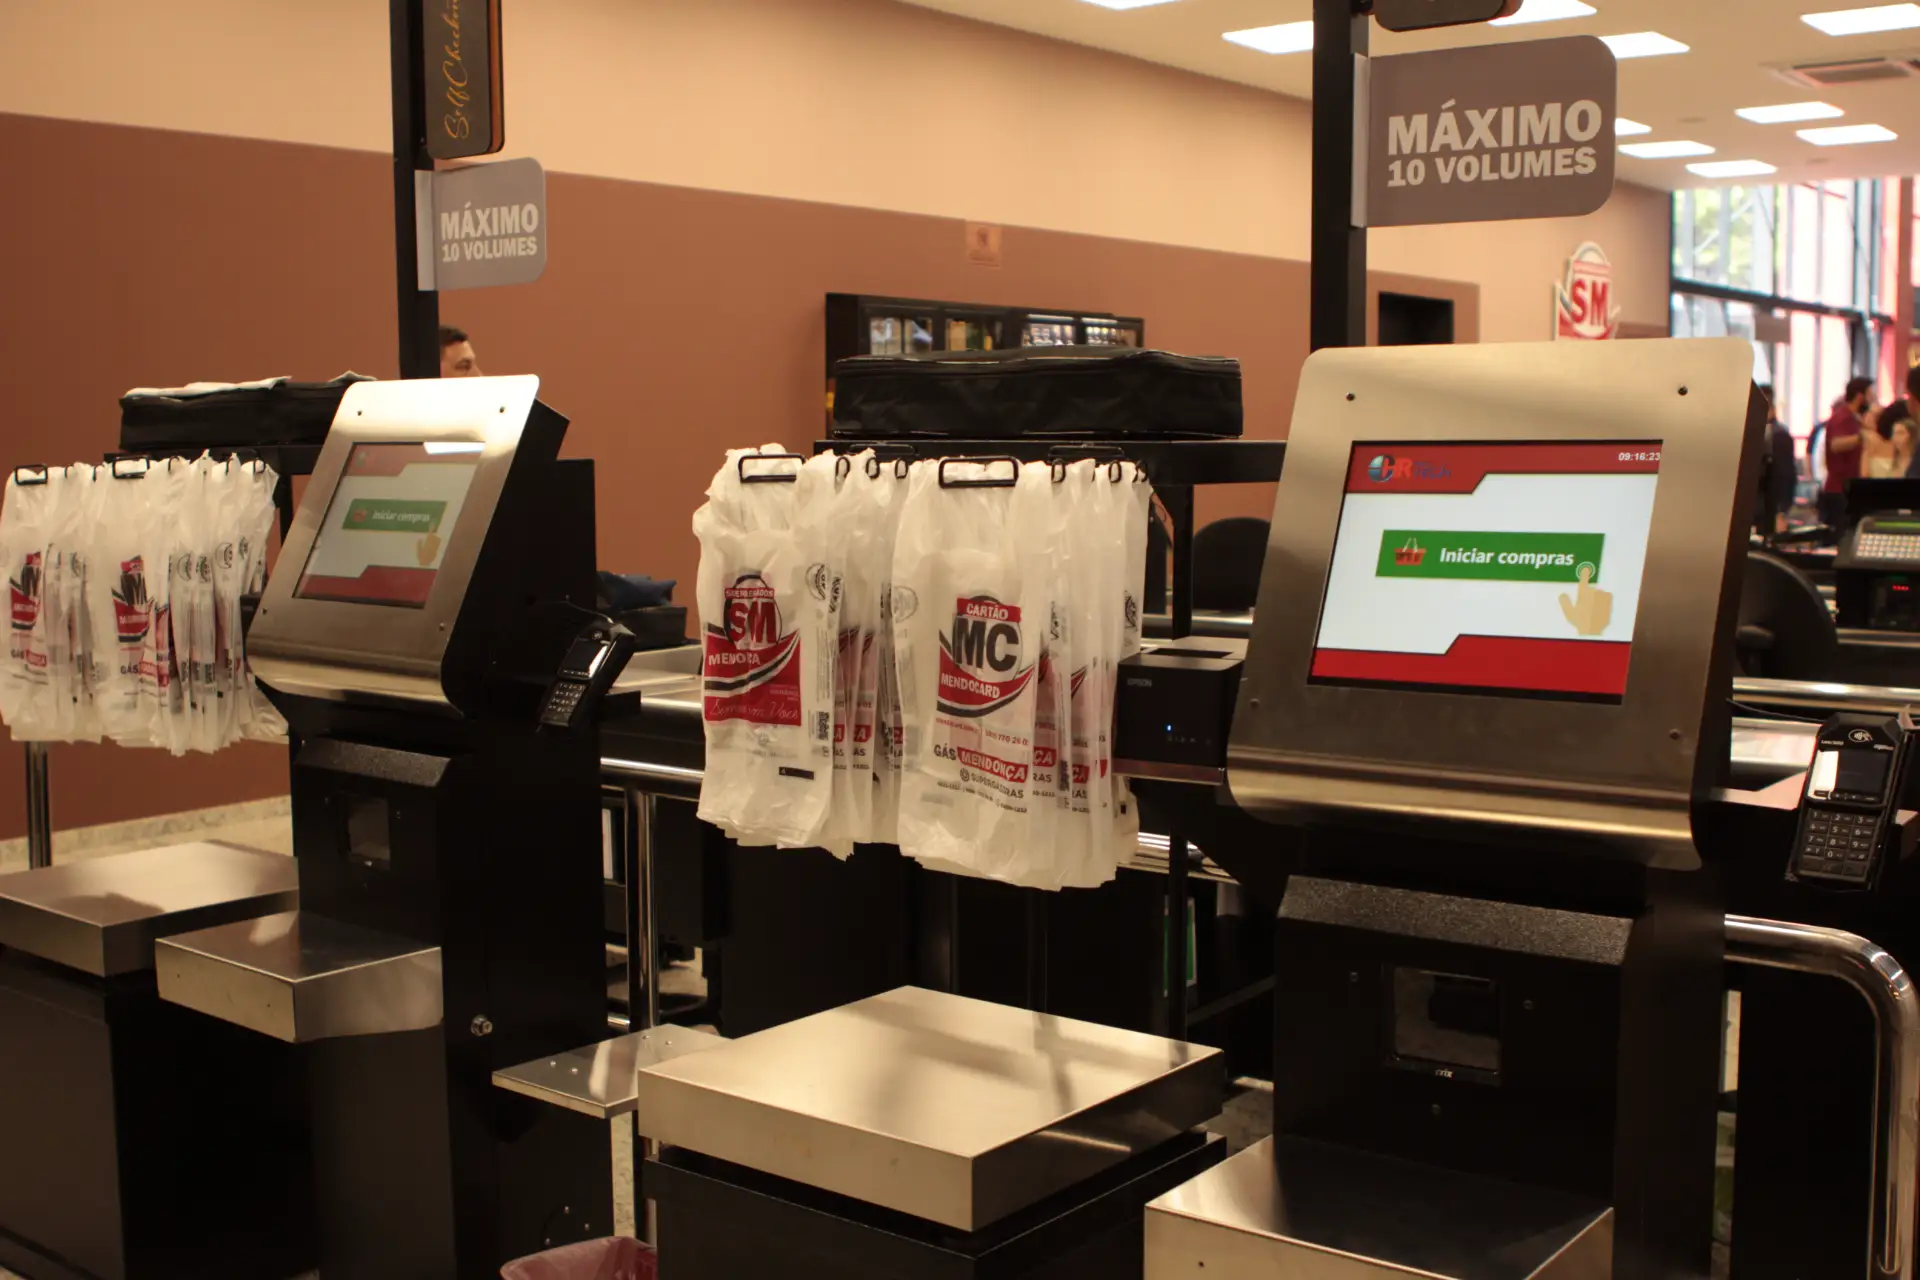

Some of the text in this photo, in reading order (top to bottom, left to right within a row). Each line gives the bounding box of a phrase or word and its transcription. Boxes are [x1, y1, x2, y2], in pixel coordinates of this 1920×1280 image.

[1387, 98, 1602, 156] MÁXIMO
[1387, 146, 1597, 187] 10 VOLUMES
[441, 200, 539, 240] MÁXIMO
[442, 236, 538, 262] 10 VOLUMES
[1571, 278, 1609, 329] SM
[1618, 451, 1661, 461] 09:16:23
[372, 510, 431, 524] Iniciar compras
[1439, 547, 1575, 570] Iniciar compras
[727, 600, 778, 643] SM
[966, 602, 1009, 620] CARTÃO
[954, 617, 1020, 673] MC
[941, 673, 1001, 699] MENDOCARD
[934, 743, 956, 760] GÁS
[961, 750, 1026, 781] MENDONÇA
